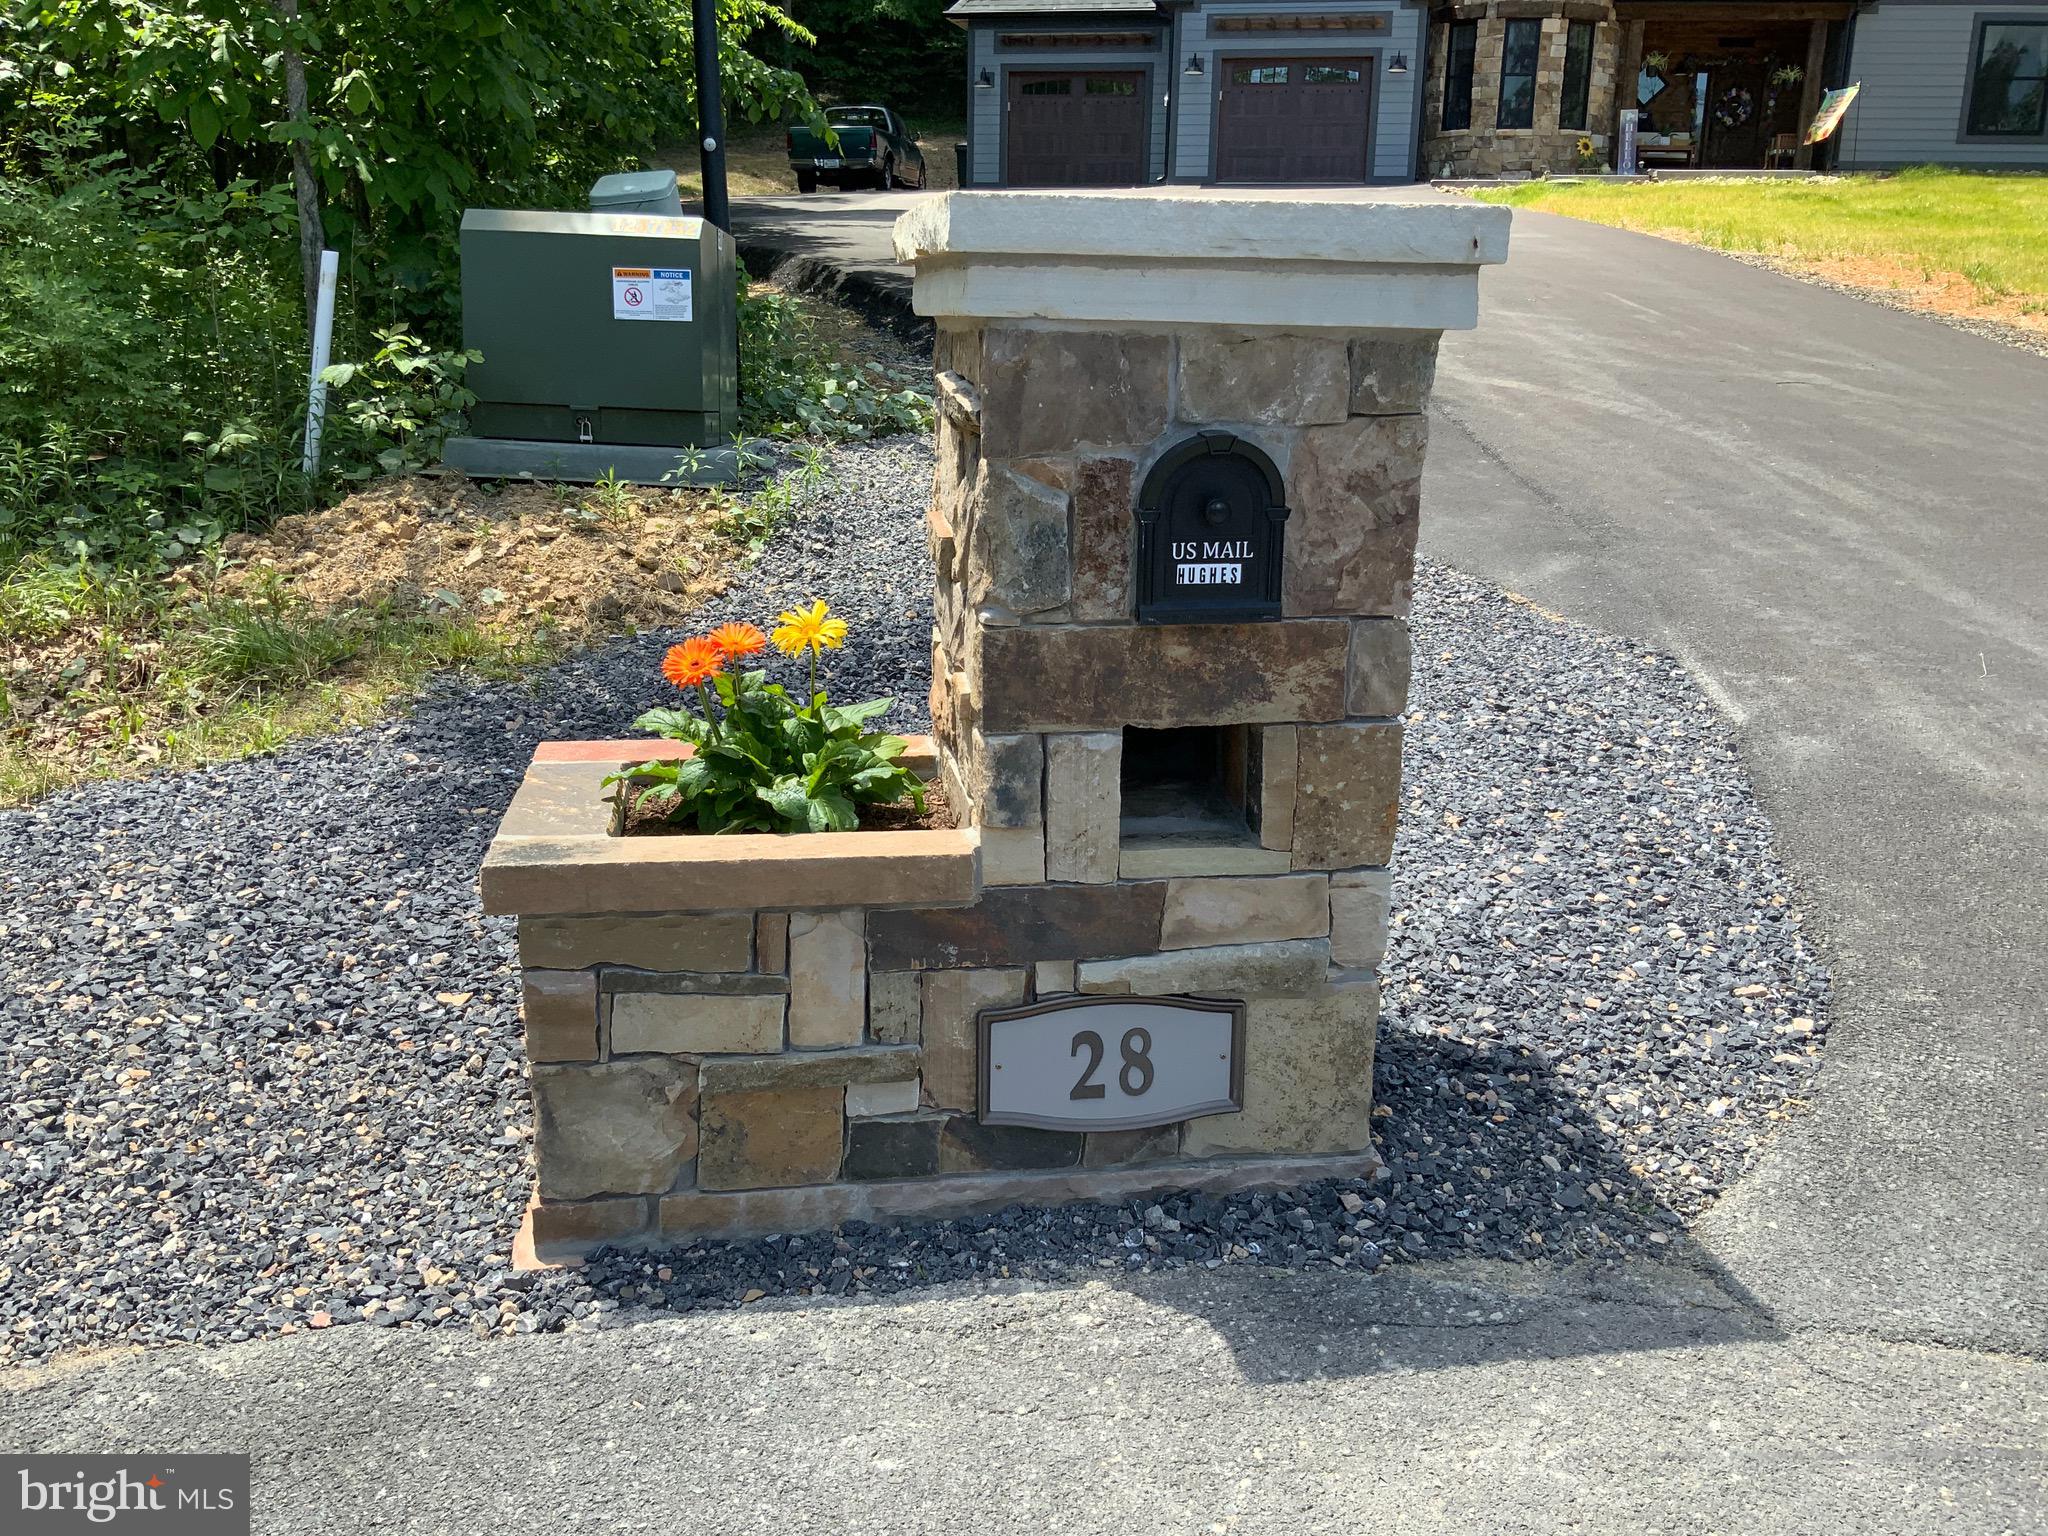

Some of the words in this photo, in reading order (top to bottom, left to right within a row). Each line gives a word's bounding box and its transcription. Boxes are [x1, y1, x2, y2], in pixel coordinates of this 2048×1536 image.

[1172, 542, 1197, 560] US
[1202, 541, 1254, 559] MAIL
[1178, 567, 1238, 584] HUGHES
[1070, 1027, 1154, 1101] 28
